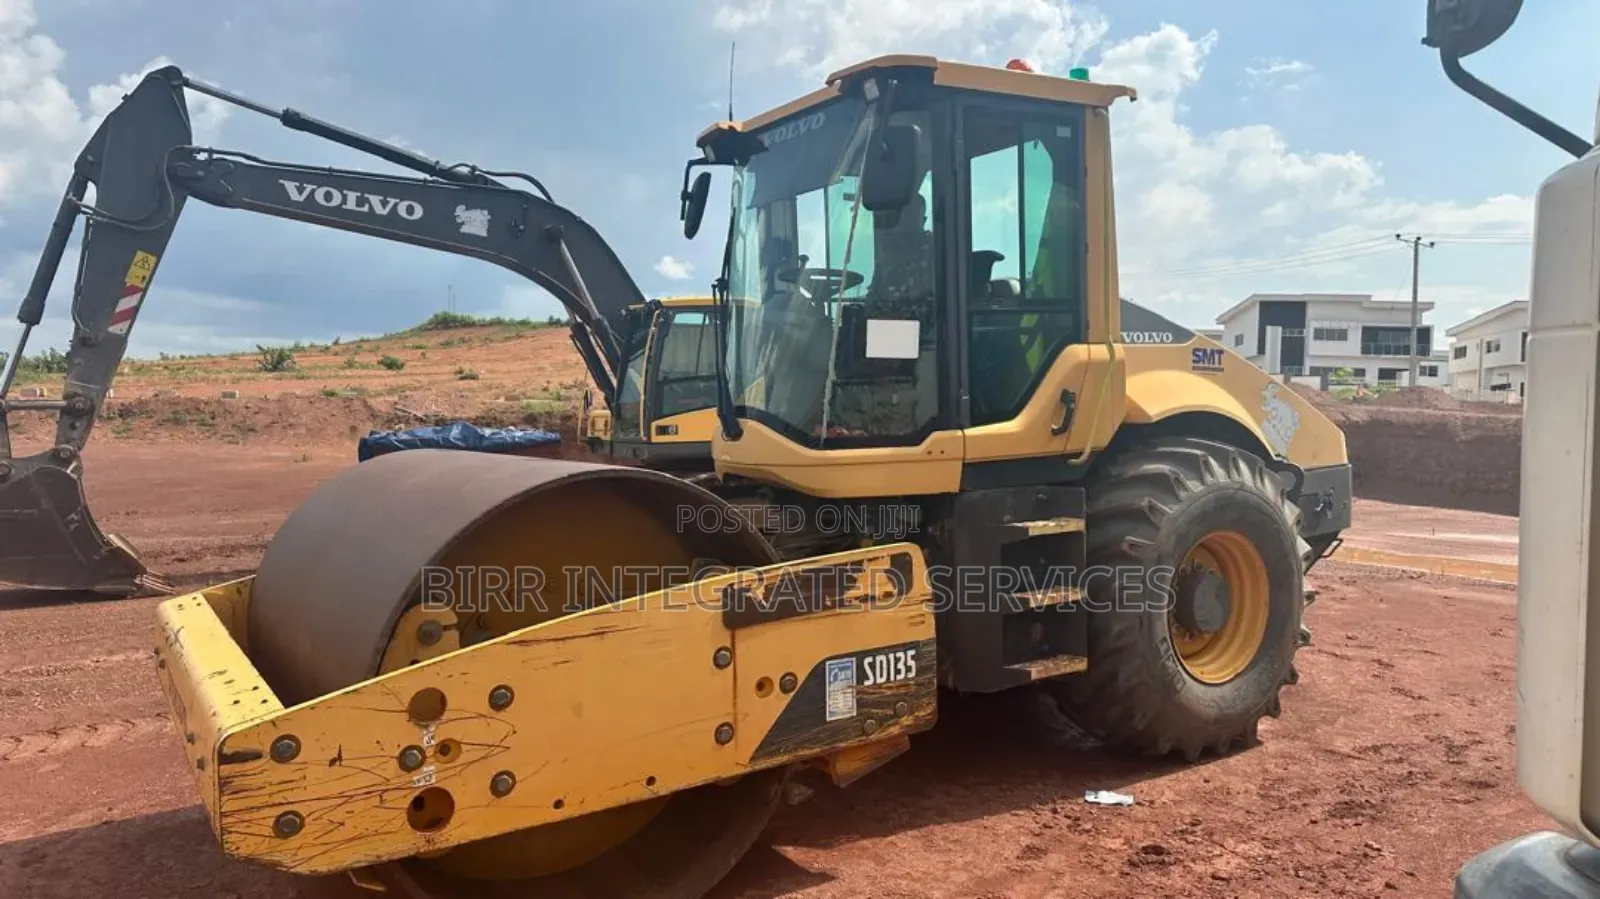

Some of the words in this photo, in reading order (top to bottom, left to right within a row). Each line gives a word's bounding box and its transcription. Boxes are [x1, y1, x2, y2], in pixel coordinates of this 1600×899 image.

[758, 111, 827, 147] VOLVO
[278, 179, 424, 220] VOLVO
[1121, 331, 1173, 343] VOLVO
[1192, 347, 1225, 366] SMT
[863, 649, 917, 687] SD135
